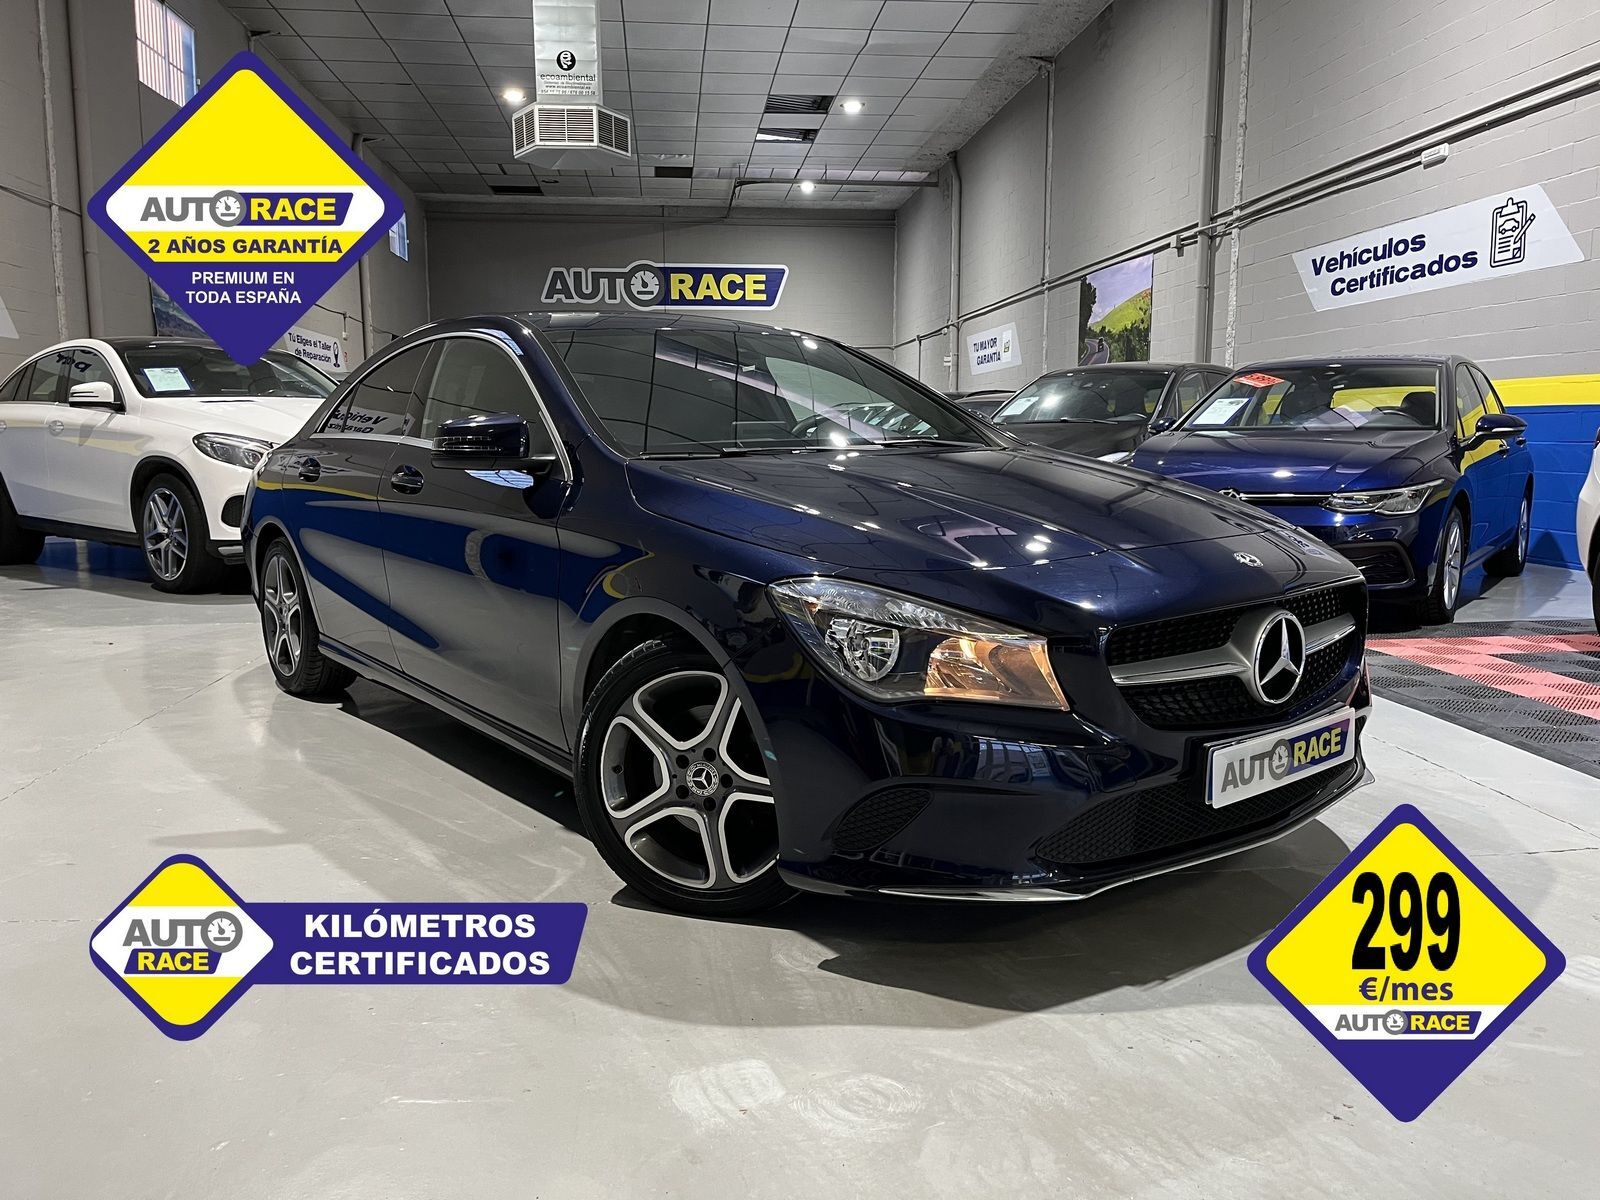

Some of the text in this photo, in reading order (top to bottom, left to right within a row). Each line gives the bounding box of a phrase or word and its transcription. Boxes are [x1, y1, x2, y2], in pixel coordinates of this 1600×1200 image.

[1311, 233, 1426, 276] Vehículos
[1330, 250, 1479, 296] Certificados
[296, 334, 312, 347] Eliges
[313, 339, 318, 348] el
[318, 340, 332, 351] Taller
[973, 337, 997, 352] TU MAYOR
[294, 347, 332, 363] de Reparación
